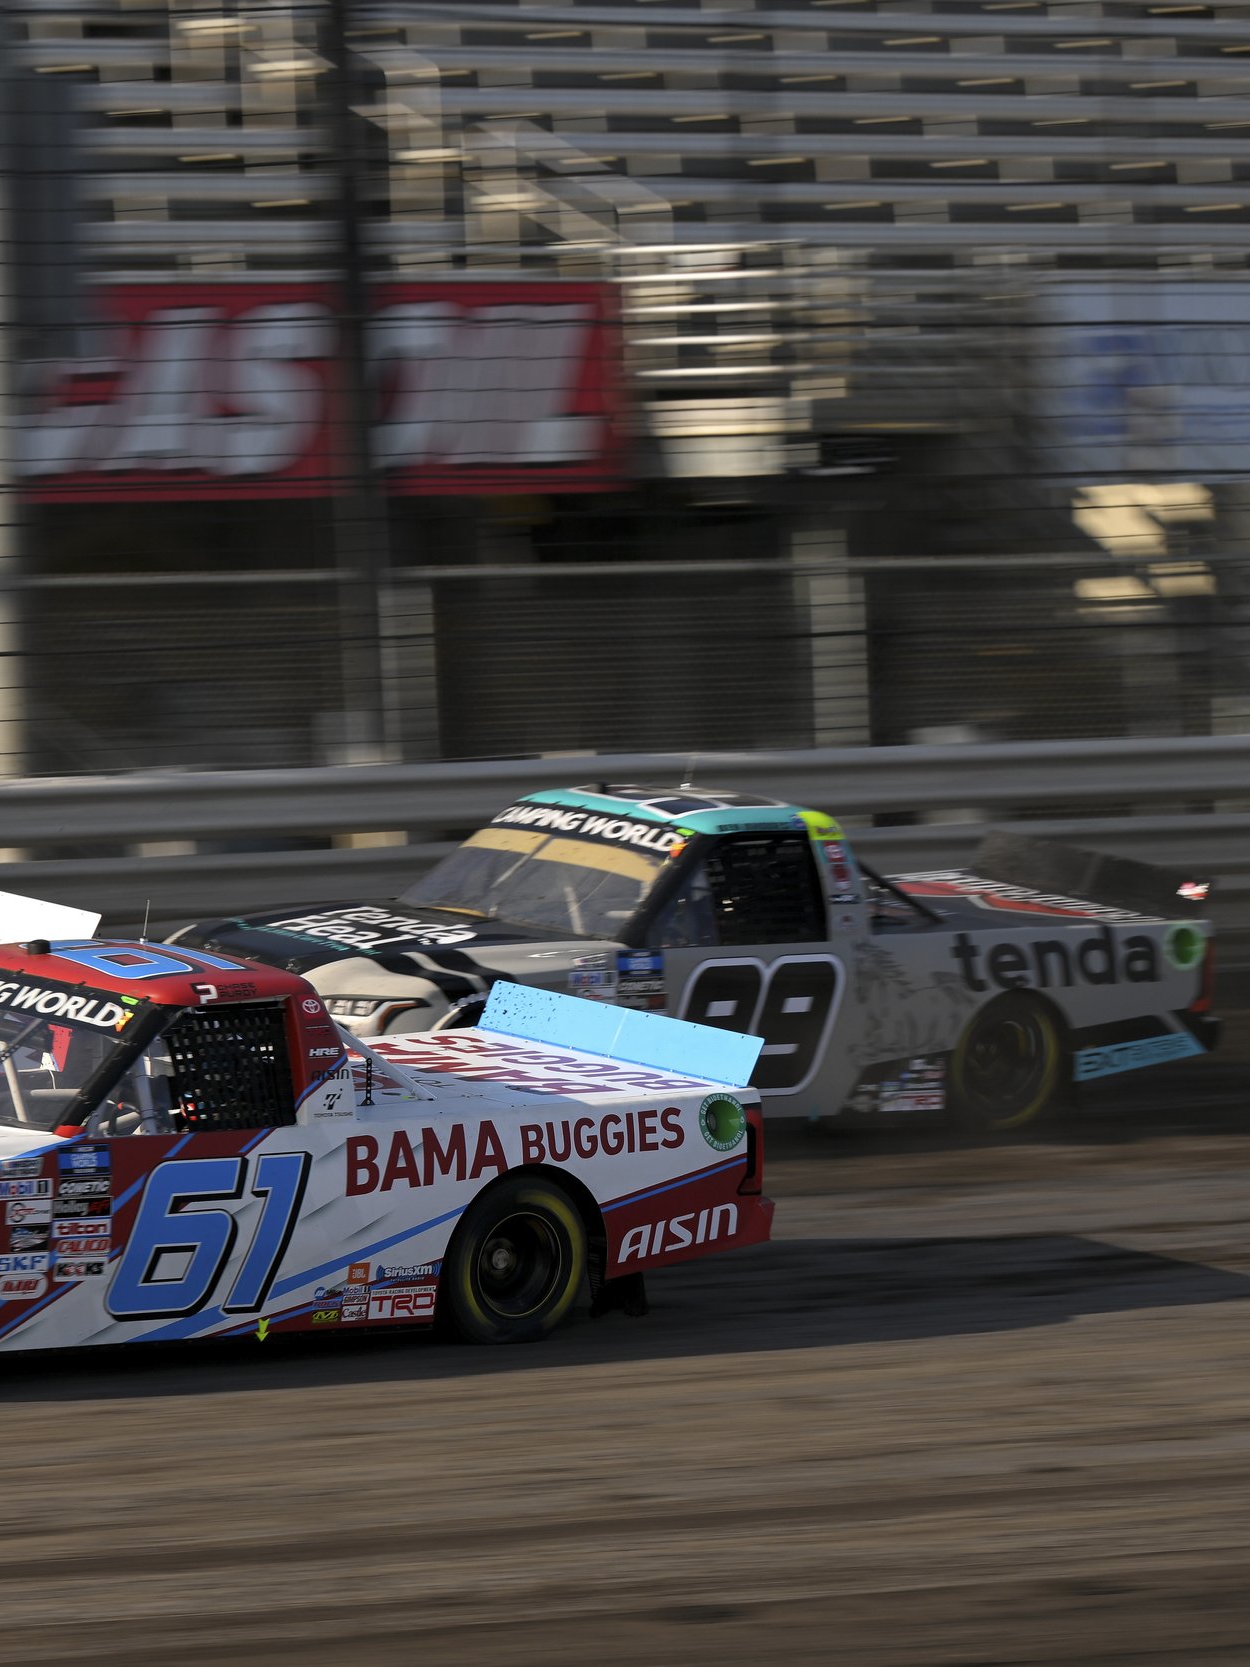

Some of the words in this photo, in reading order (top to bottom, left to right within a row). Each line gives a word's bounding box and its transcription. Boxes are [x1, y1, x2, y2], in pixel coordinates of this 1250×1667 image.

[492, 805, 587, 831] CAMPING
[581, 816, 686, 852] WORLD
[953, 925, 1161, 992] tenda
[11, 985, 126, 1028] WORLD
[347, 1119, 508, 1196] BAMA
[521, 1107, 686, 1165] BUGGIES
[105, 1151, 312, 1320] 61
[617, 1202, 739, 1264] AISIN
[352, 1269, 366, 1279] JBL
[370, 1292, 436, 1317] TRD
